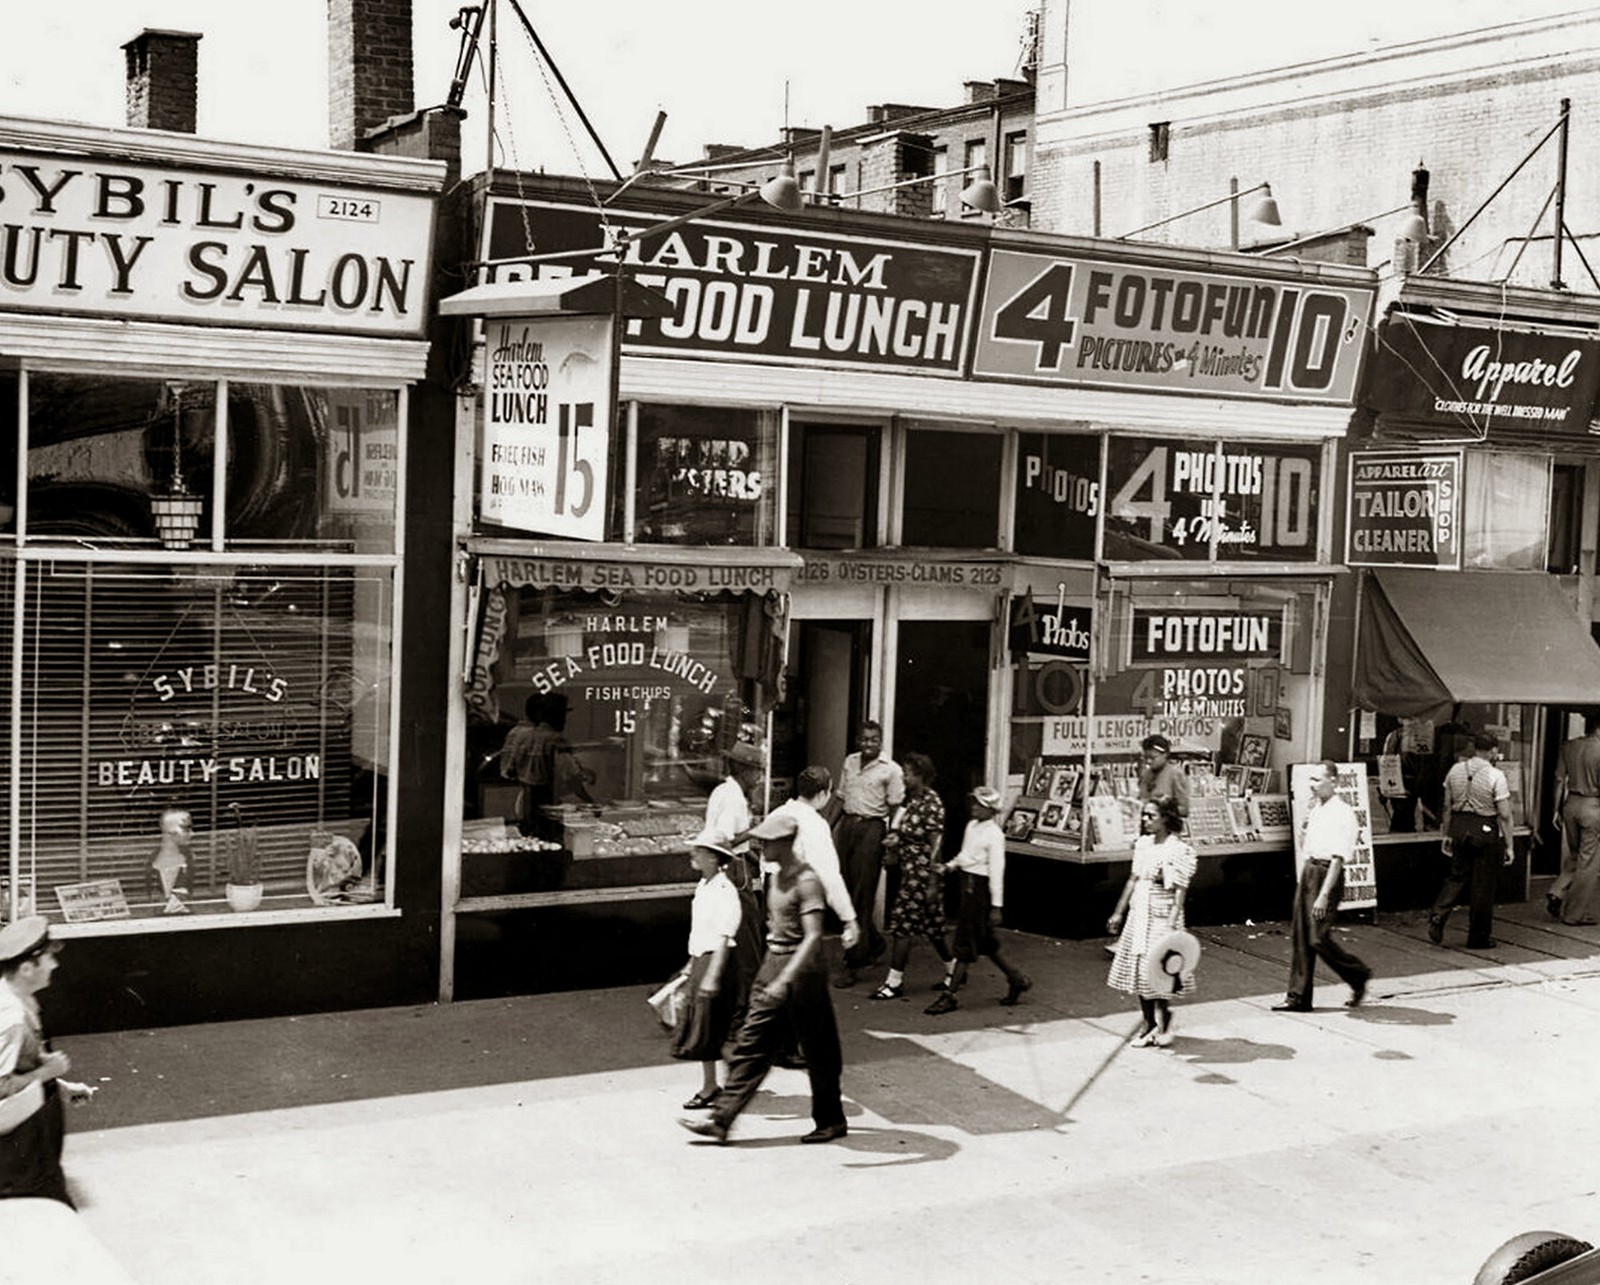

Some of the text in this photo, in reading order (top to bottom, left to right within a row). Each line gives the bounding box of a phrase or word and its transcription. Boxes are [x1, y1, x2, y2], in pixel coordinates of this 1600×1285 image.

[0, 164, 298, 234] YBIL'S
[329, 200, 373, 219] 2124
[594, 223, 893, 289] HARLEM
[183, 241, 415, 314] SALON
[789, 288, 961, 361] LUNCH
[992, 263, 1077, 370] 4
[492, 325, 543, 363] Harlem
[1076, 335, 1175, 374] PICTURES
[1184, 340, 1200, 378] 4
[1198, 345, 1264, 382] Minutes
[493, 363, 549, 390] SEA FOOD
[1461, 345, 1583, 402] Apparel
[492, 392, 548, 424] LUNCH
[554, 402, 594, 517] 15
[1173, 452, 1262, 494] PHOTOS
[1355, 465, 1420, 479] APPAREL
[669, 467, 761, 500] STERS
[1111, 446, 1172, 544] 4
[1355, 490, 1435, 518] TAILOR
[1172, 517, 1257, 546] 4 Minutes
[1353, 529, 1431, 553] CLEANER
[496, 561, 776, 587] HARLEM SEA FOOD LUNCH
[479, 588, 507, 658] LUNC
[586, 616, 668, 633] HARLEM
[1147, 616, 1269, 653] FOTOFUN
[152, 664, 288, 702] SYBIL'S
[532, 642, 718, 695] SEA FOOD LUNCH
[1163, 668, 1245, 696] PHOTOS
[615, 710, 637, 733] 15
[1163, 699, 1178, 718] IN
[1192, 697, 1246, 718] MINUTES
[1053, 718, 1214, 740] FULL LENGTH PHOTOS
[98, 755, 319, 786] BEAUTY SALON
